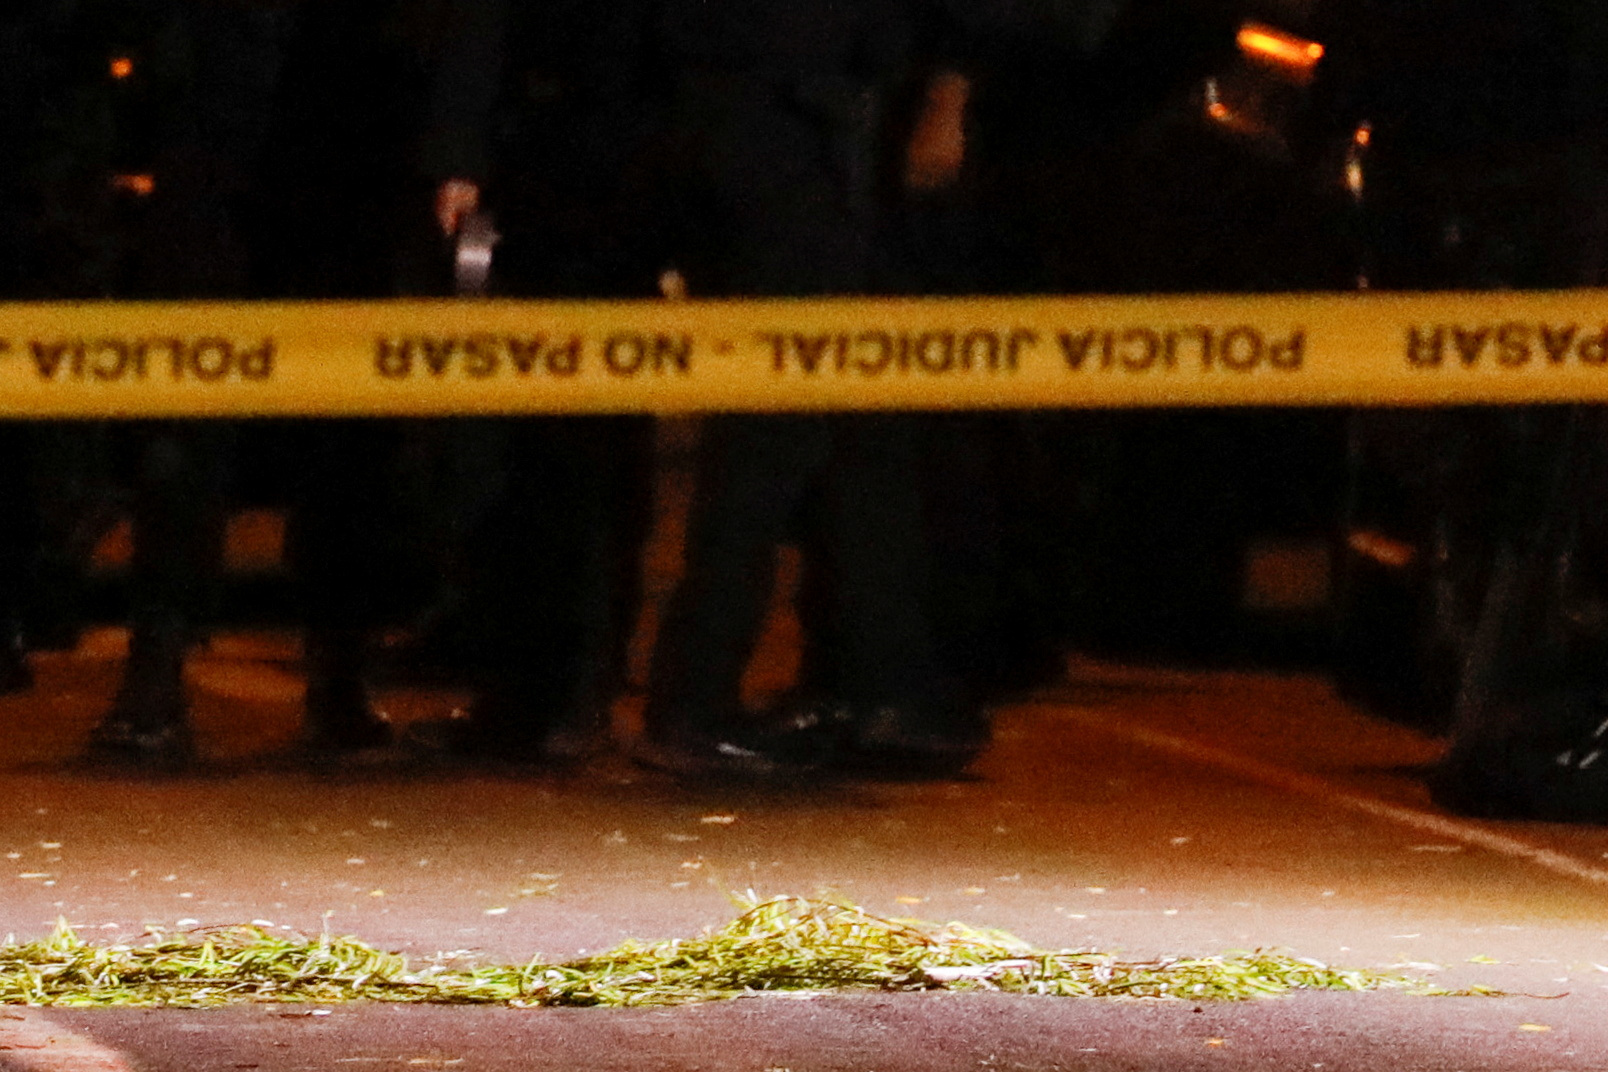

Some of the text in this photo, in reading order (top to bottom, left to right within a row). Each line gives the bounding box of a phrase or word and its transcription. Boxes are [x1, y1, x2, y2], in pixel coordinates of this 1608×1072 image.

[27, 337, 276, 380] POLICIA
[373, 334, 582, 378] PASAR
[602, 333, 693, 375] NO
[760, 329, 1037, 373] JUDICIAL
[1056, 327, 1306, 369] POLICIA
[1406, 323, 1608, 367] PASAR
